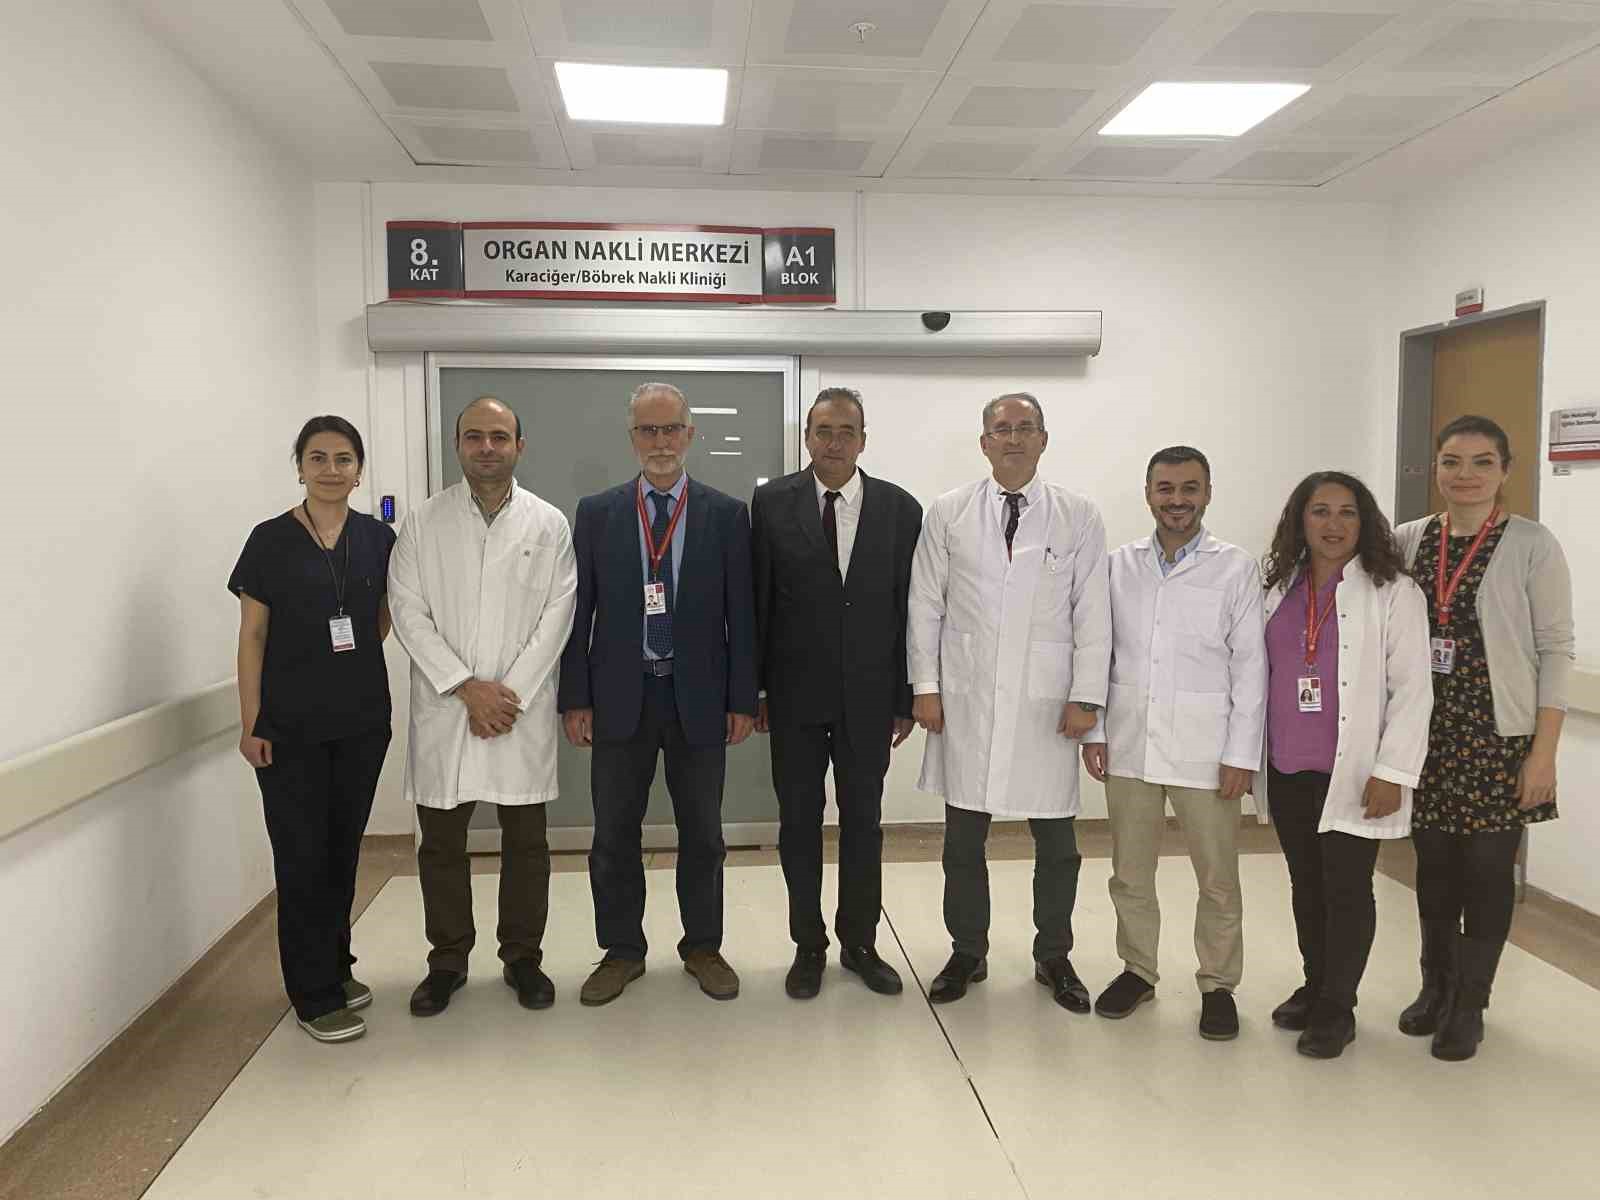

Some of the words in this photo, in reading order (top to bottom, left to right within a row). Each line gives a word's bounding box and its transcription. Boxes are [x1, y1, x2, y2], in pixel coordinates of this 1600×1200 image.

[410, 238, 439, 266] 8.
[483, 240, 568, 260] ORGAN
[574, 237, 643, 261] NAKLİ
[650, 240, 749, 265] MERKEZİ
[785, 246, 816, 267] A1
[410, 268, 439, 281] KAT
[505, 269, 635, 286] Karaciğer/Böbrek
[638, 270, 676, 285] Nakli
[680, 270, 727, 289] Kliniği
[780, 272, 819, 285] BLOK
